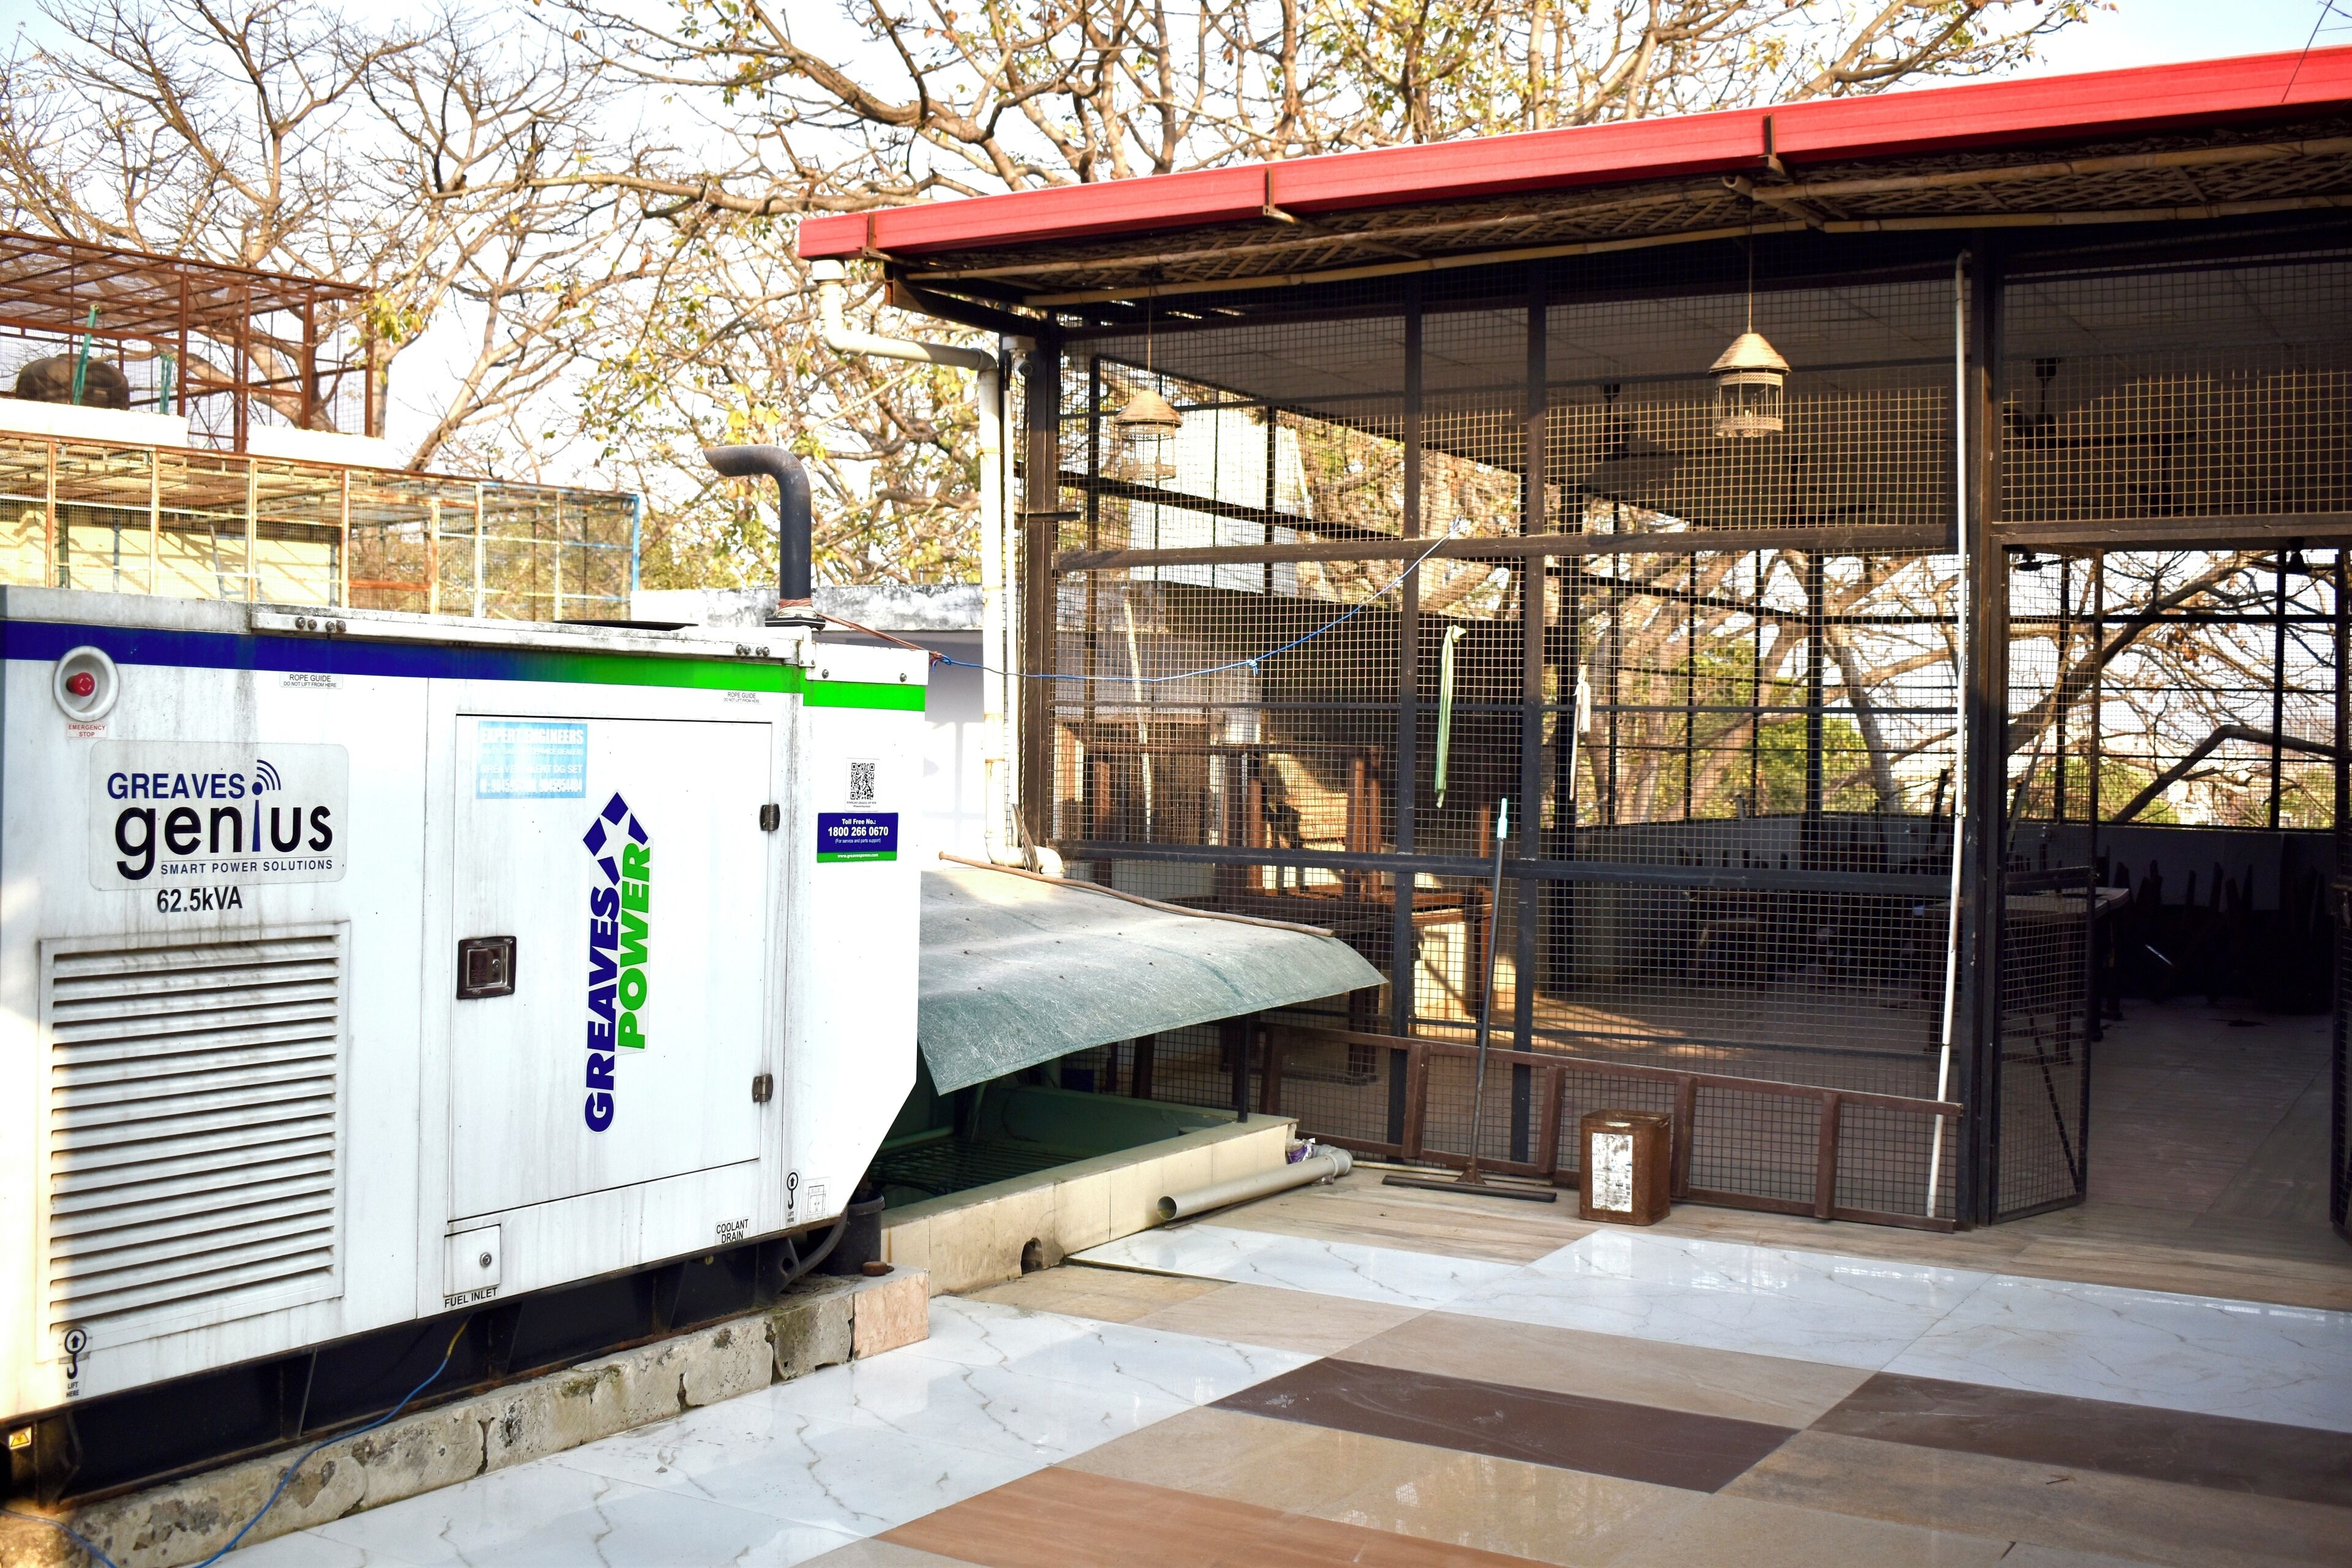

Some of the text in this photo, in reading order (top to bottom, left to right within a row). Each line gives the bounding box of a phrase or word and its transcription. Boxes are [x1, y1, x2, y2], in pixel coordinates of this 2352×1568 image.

[553, 764, 565, 774] DG
[567, 764, 584, 774] SET
[107, 772, 246, 799] GREAVES
[115, 782, 333, 880] genius
[827, 826, 889, 837] 1800 266 0670
[160, 860, 333, 875] SMART POWER SOLUTIONS
[157, 886, 243, 913] 62.5kVA
[617, 842, 650, 1050] POWER
[584, 886, 620, 1133] GREAVES
[716, 1219, 748, 1234] COOLANT
[722, 1230, 744, 1243] DRAIN
[445, 1294, 469, 1308] FUEL
[471, 1287, 498, 1302] INLET
[66, 1389, 80, 1398] HERE
